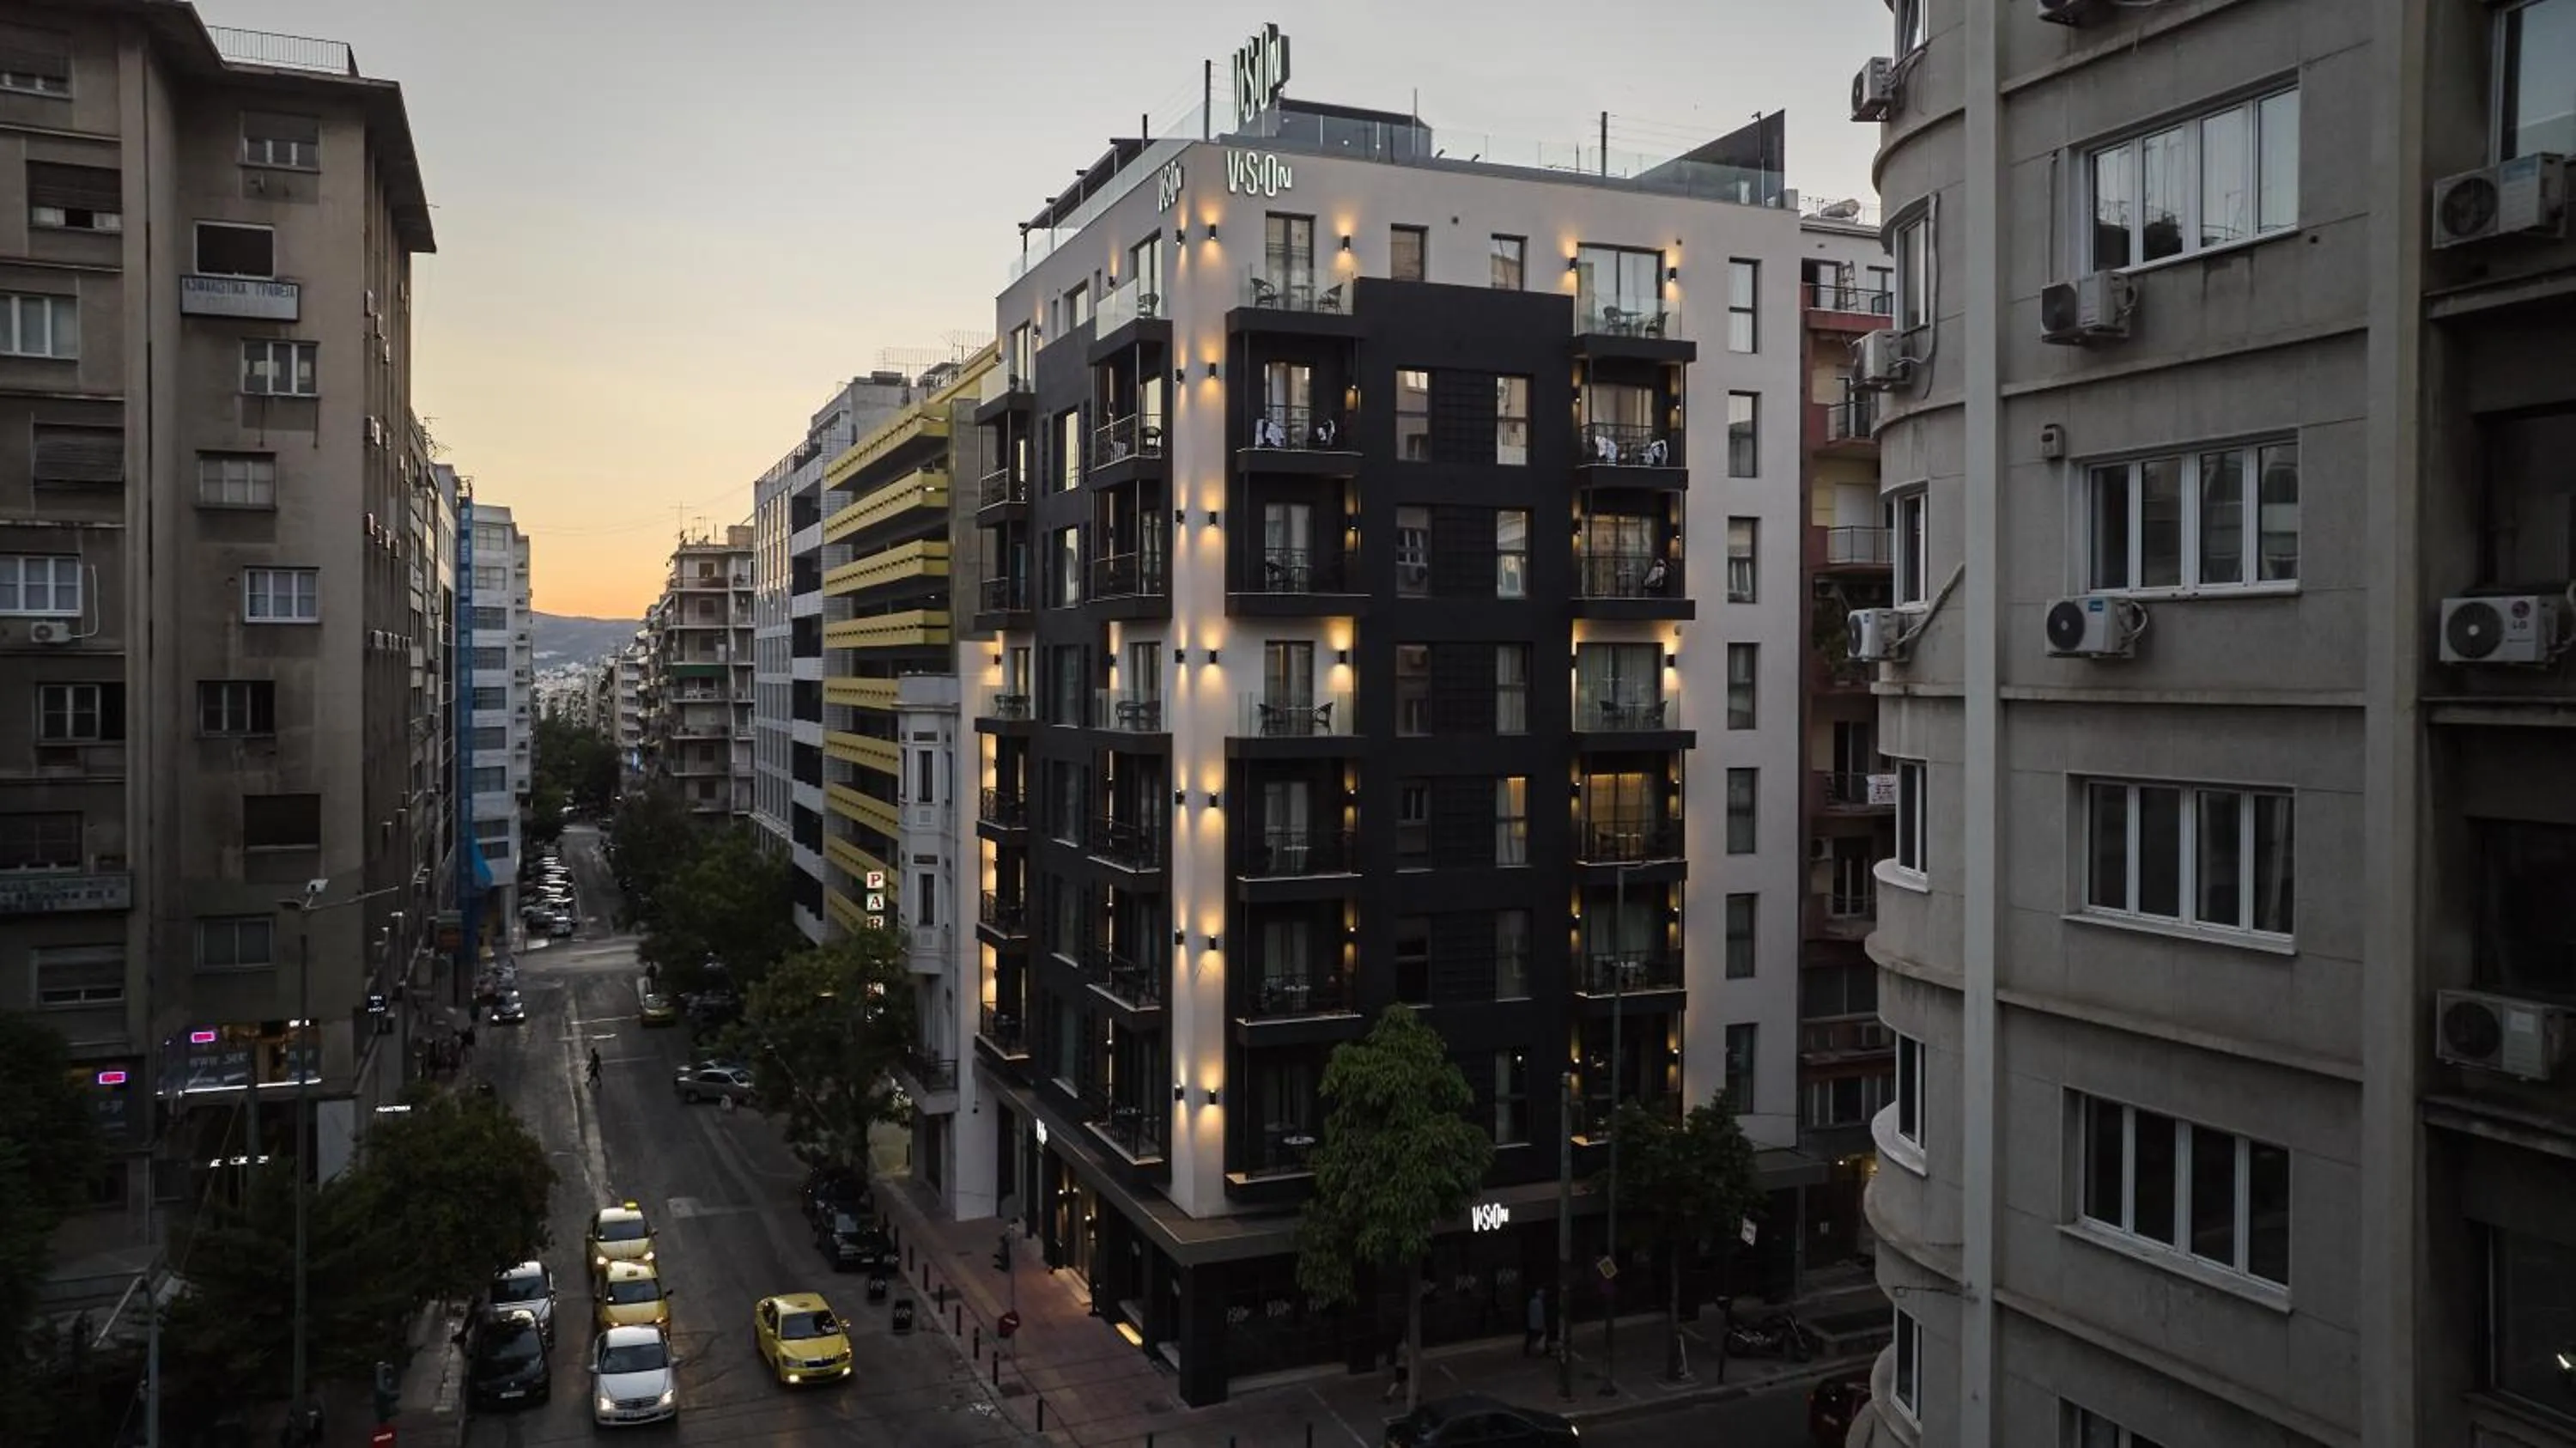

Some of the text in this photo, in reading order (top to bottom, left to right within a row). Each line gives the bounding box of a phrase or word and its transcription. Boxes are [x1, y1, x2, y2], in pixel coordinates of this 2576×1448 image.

[1231, 22, 1285, 134] VISION
[1226, 150, 1291, 197] VISION
[1471, 1202, 1510, 1232] VISION
